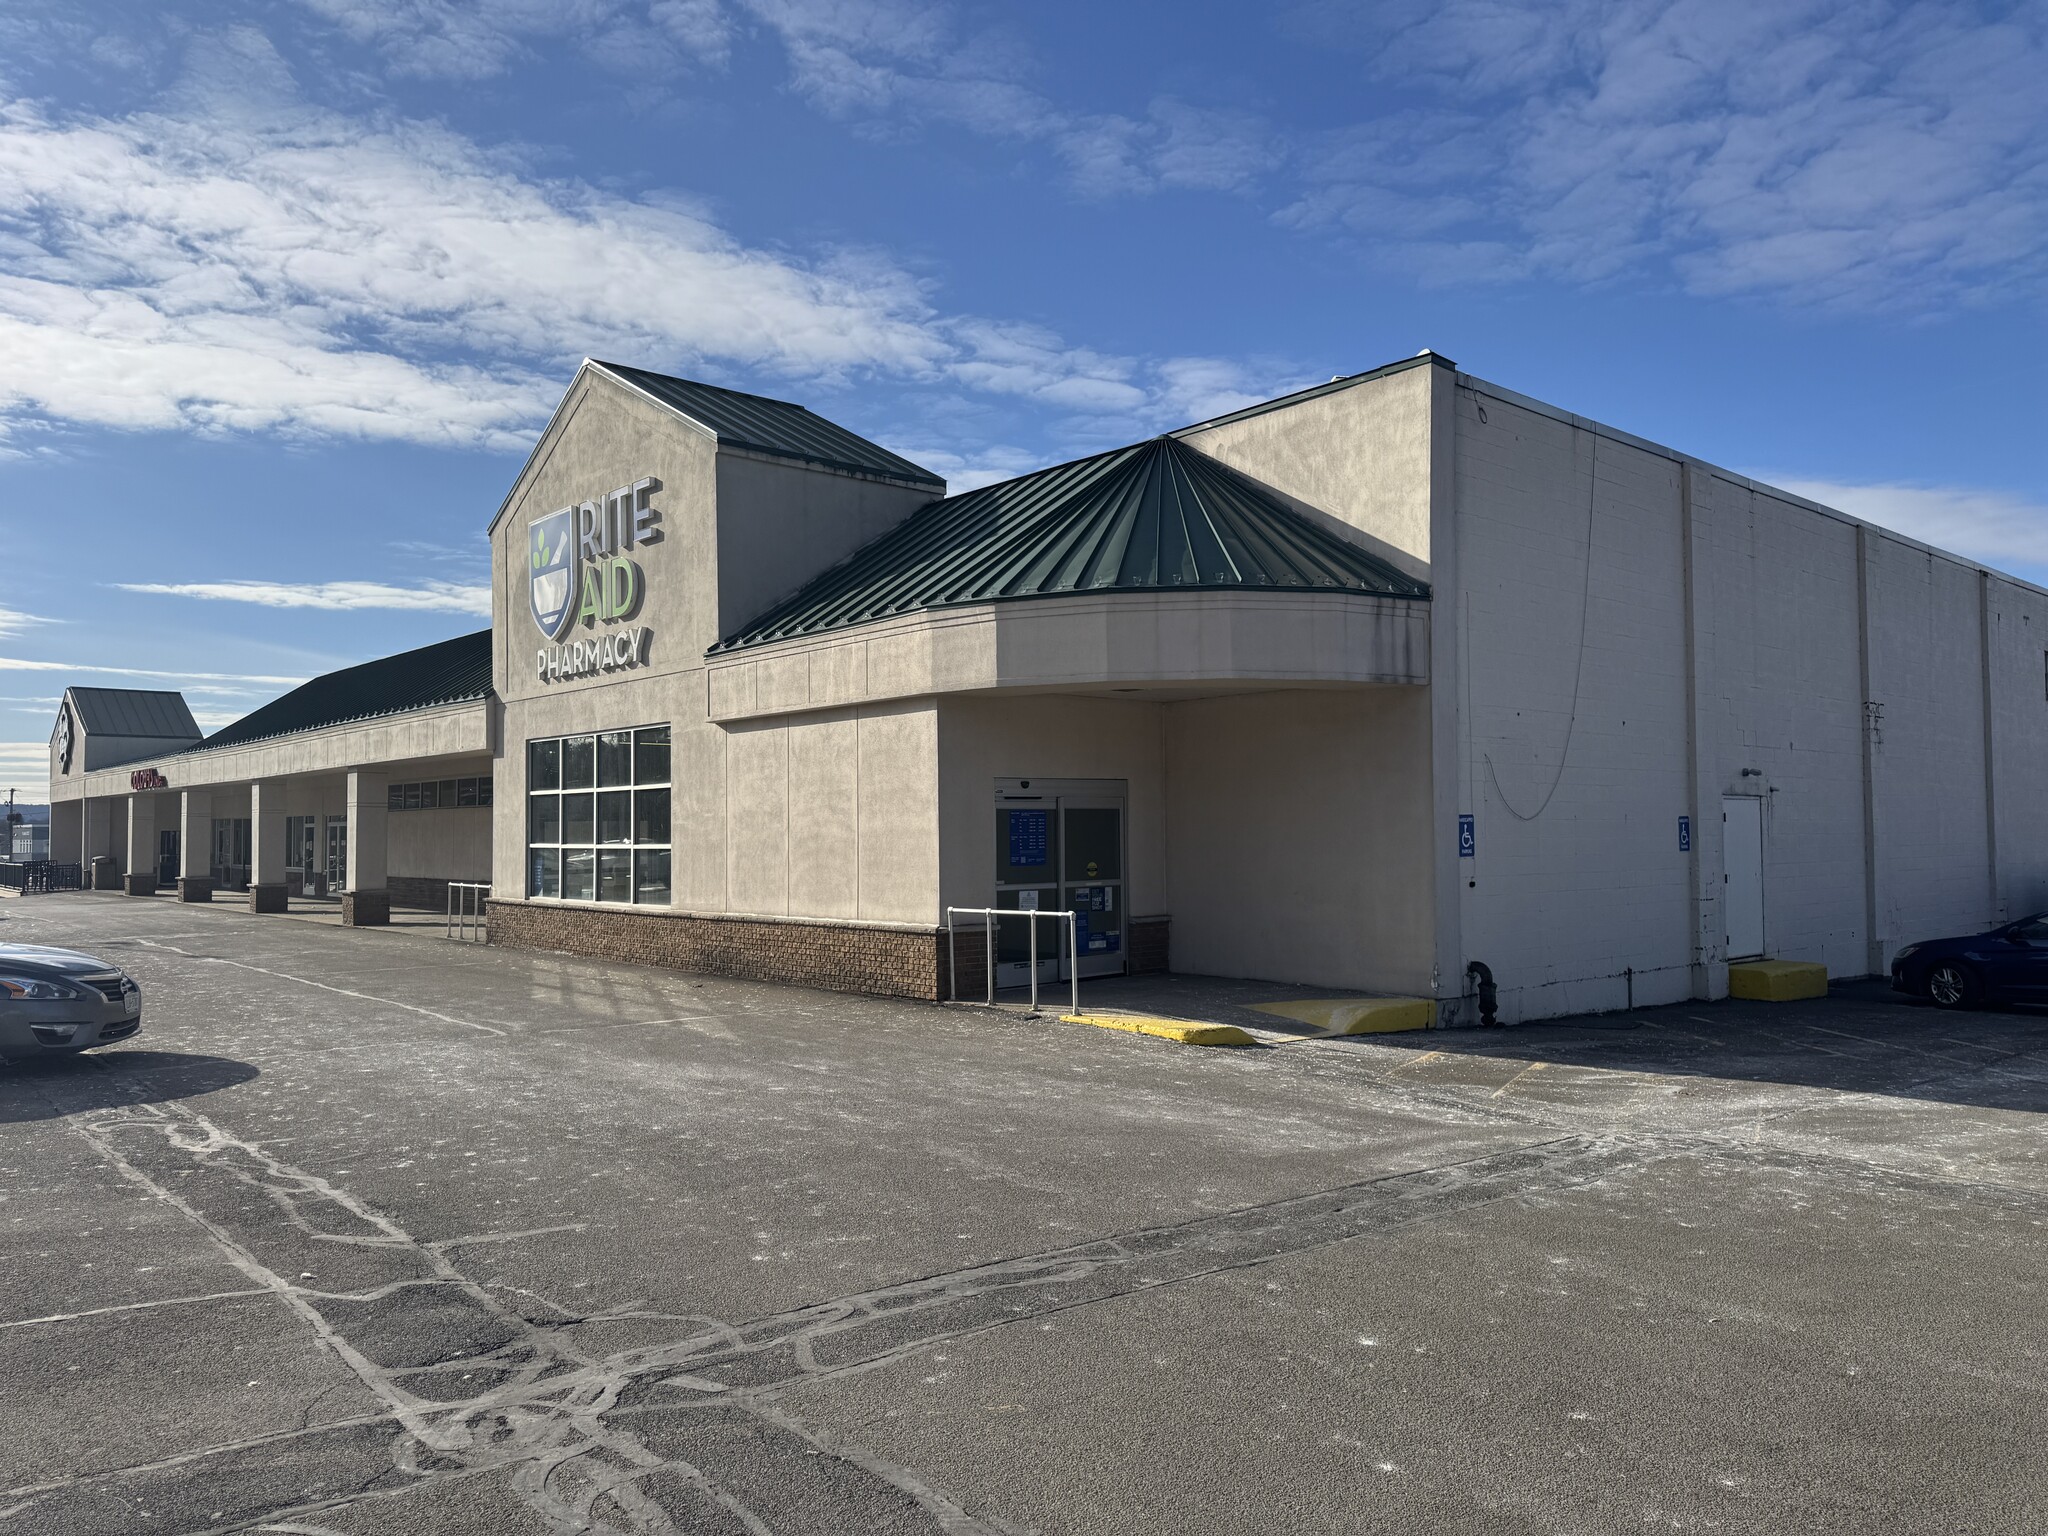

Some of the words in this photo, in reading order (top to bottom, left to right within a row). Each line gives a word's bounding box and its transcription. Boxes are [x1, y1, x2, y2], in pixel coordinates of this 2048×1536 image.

[579, 476, 655, 559] RITE
[578, 556, 636, 624] AID
[537, 627, 645, 680] PHARMACY
